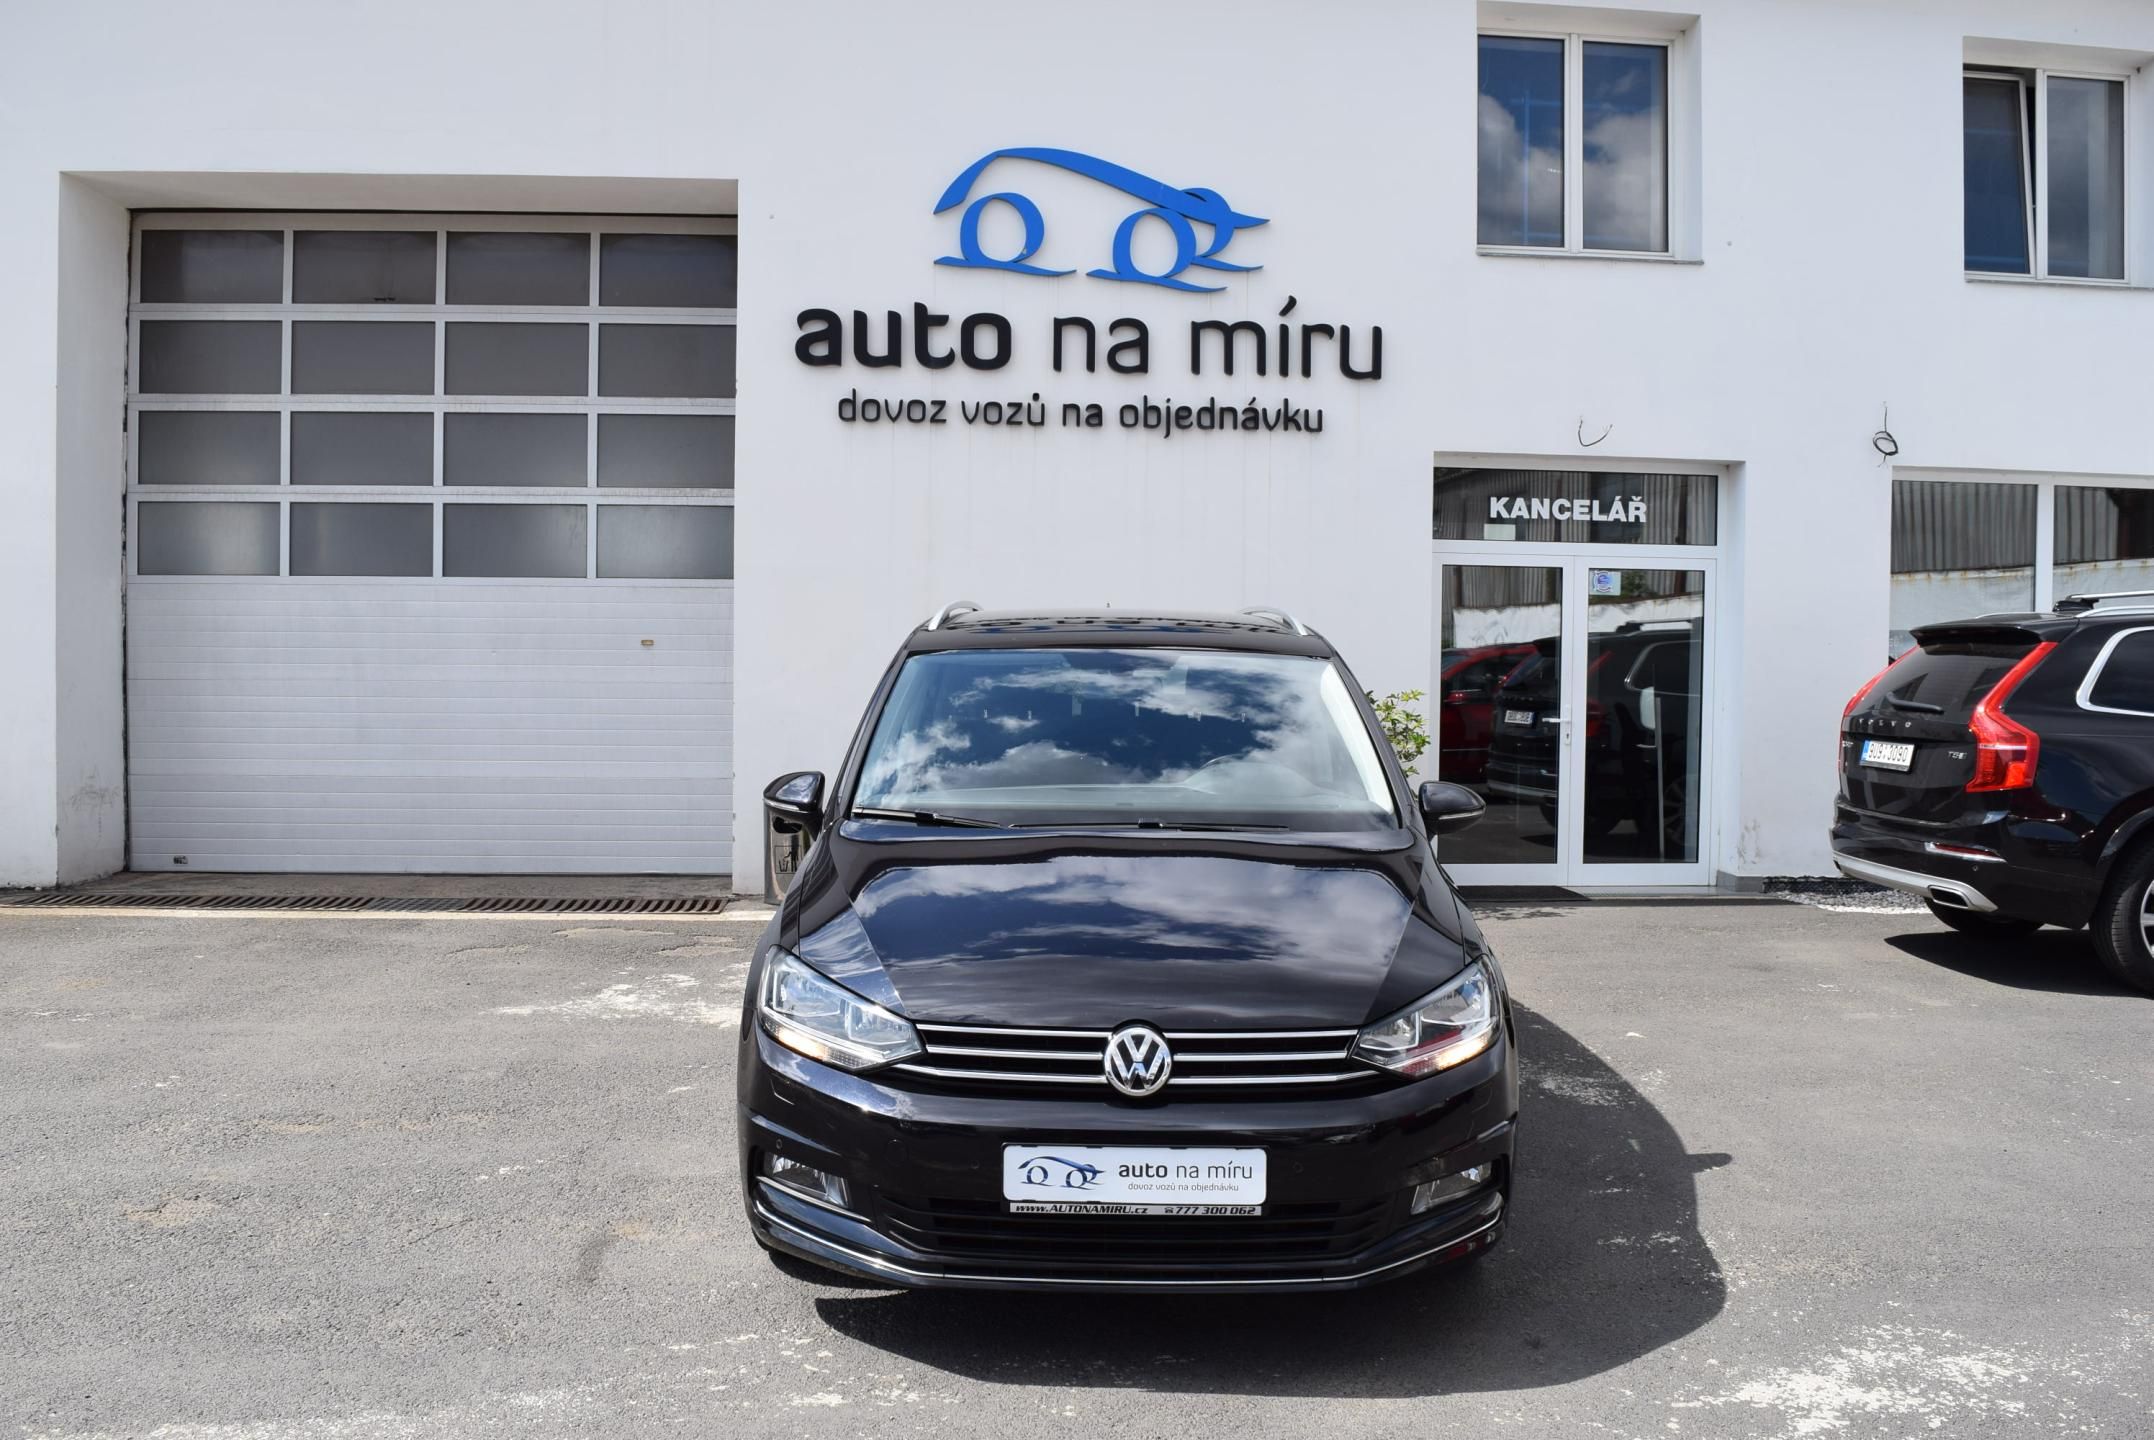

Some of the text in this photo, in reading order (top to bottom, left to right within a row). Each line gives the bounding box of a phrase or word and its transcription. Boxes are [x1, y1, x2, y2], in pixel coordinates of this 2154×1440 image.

[794, 295, 1383, 381] auto na míru
[838, 388, 1323, 440] dovoz vozů na objednávku
[1489, 495, 1648, 523] KANCELÁŘ
[1118, 1160, 1253, 1180] auto na míru
[1127, 1182, 1239, 1193] dovoz vozů na objednávku
[1016, 1204, 1256, 1215] www.AUTONAMIRU.cz 777 300 062
